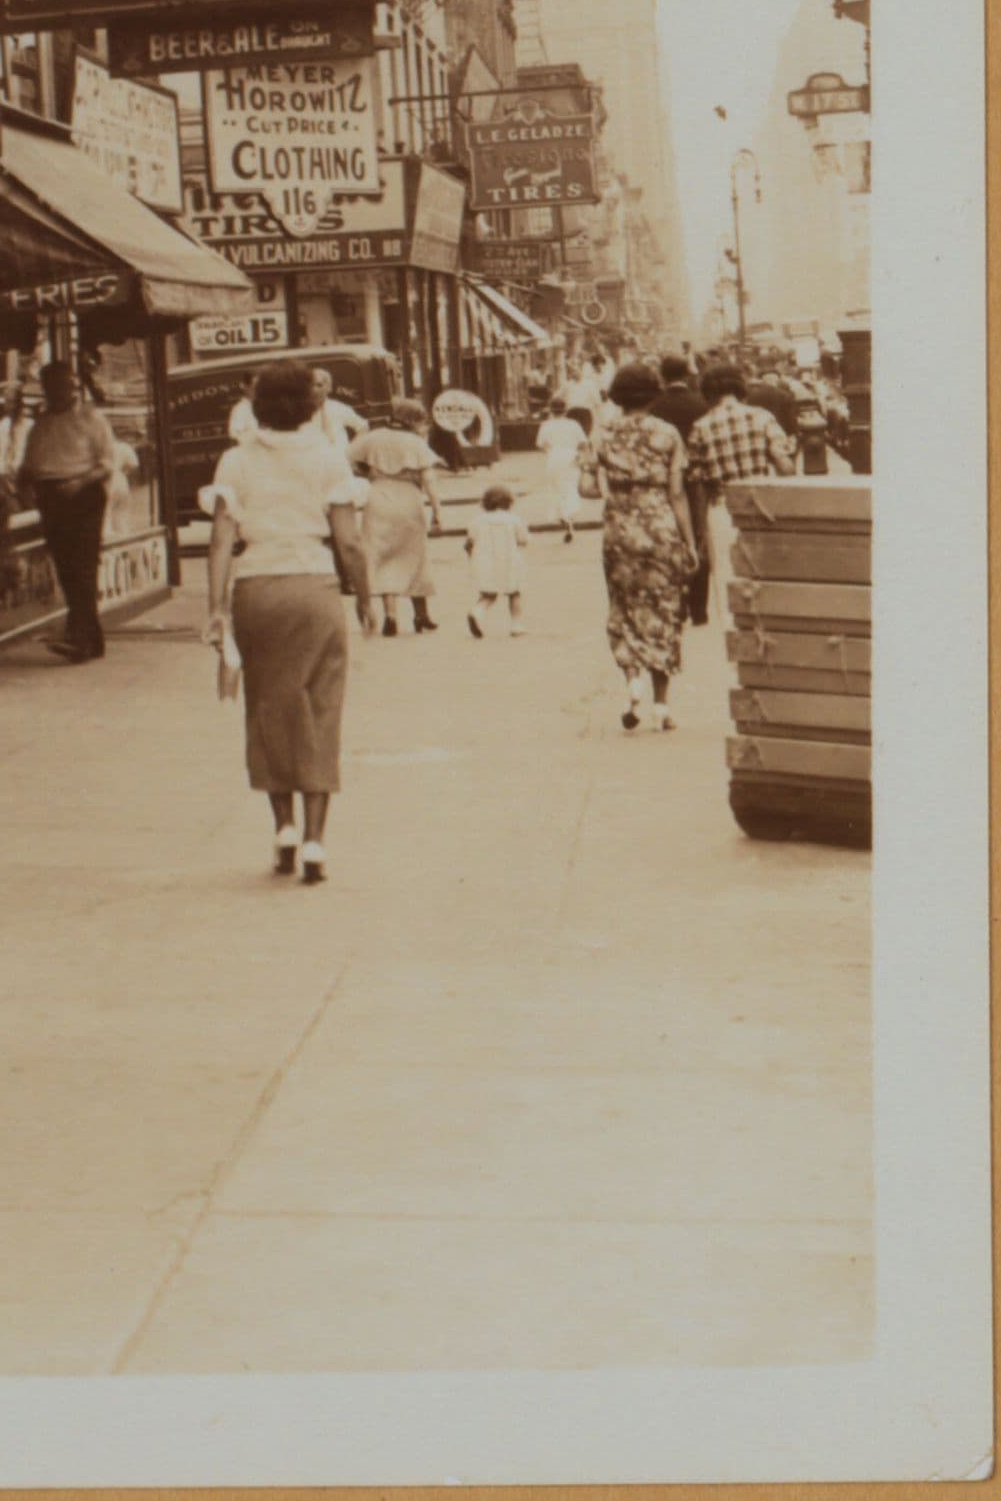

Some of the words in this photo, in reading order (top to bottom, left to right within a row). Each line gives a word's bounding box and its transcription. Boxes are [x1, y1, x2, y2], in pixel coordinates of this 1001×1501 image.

[244, 63, 336, 84] MEYER
[216, 68, 368, 113] HOROWITZ
[246, 116, 283, 134] CUT
[287, 116, 337, 135] PRICE
[231, 139, 366, 181] CLOTHING
[283, 186, 317, 216] 116
[487, 182, 584, 204] TIRES
[191, 209, 345, 238] TIRS
[230, 240, 340, 267] VULCANIZING
[349, 238, 377, 260] CO.
[214, 329, 249, 345] OIL
[250, 317, 281, 344] 15
